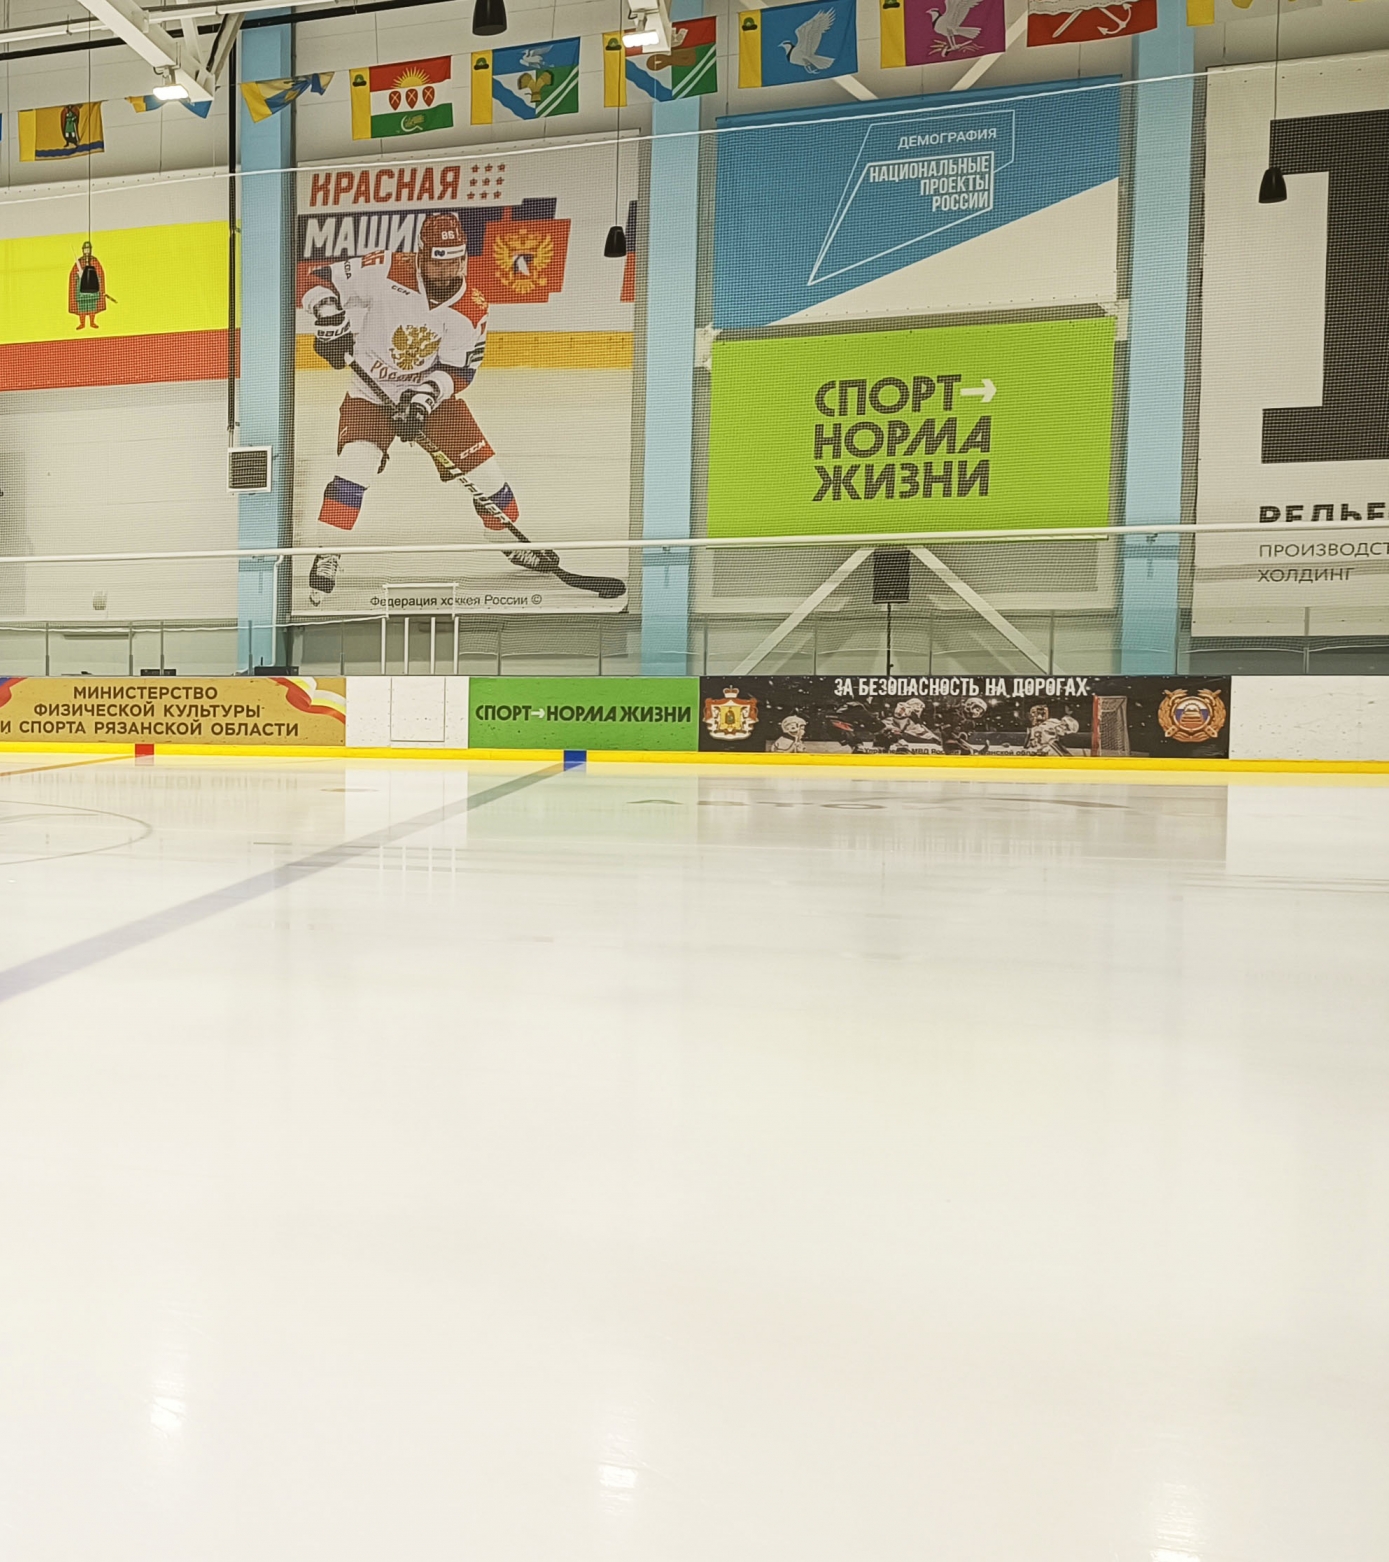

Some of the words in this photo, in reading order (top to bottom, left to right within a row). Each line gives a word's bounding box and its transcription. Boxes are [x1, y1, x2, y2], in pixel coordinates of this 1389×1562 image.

[897, 128, 997, 150] ДЕМОГРАФИЯ
[869, 156, 989, 185] НАЦИОНАЛЬНЫЕ
[310, 166, 461, 207] КРАСНАЯ
[920, 174, 989, 197] ПРОЕКТЫ
[931, 191, 988, 213] РОССИИ
[441, 231, 454, 240] 86
[814, 374, 961, 417] СПОРТ
[813, 415, 991, 459] НОРМА
[812, 459, 990, 501] ЖИЗНИ
[1258, 568, 1355, 583] ХОЛДИНГ
[370, 596, 437, 608] Федерация
[485, 594, 528, 605] России
[73, 686, 218, 700] МИНИСТЕРСТВО
[834, 678, 853, 697] ЗА
[858, 677, 979, 696] БЕЗОПАСНОСТЬ
[985, 678, 1007, 696] НА
[1013, 678, 1088, 697] ДОРОГАХ
[33, 701, 156, 718] ФИЗИЧЕСКОЙ
[163, 704, 261, 718] КУЛЬТУРЫ
[475, 704, 531, 722] СПОРТ
[547, 705, 617, 722] НОРМА
[621, 706, 692, 722] ЖИЗНИ
[0, 721, 11, 733] И
[19, 721, 87, 734] СПОРТА
[94, 718, 202, 736] РЯЗАНСКОЙ
[211, 723, 299, 736] ОБЛАСТИ
